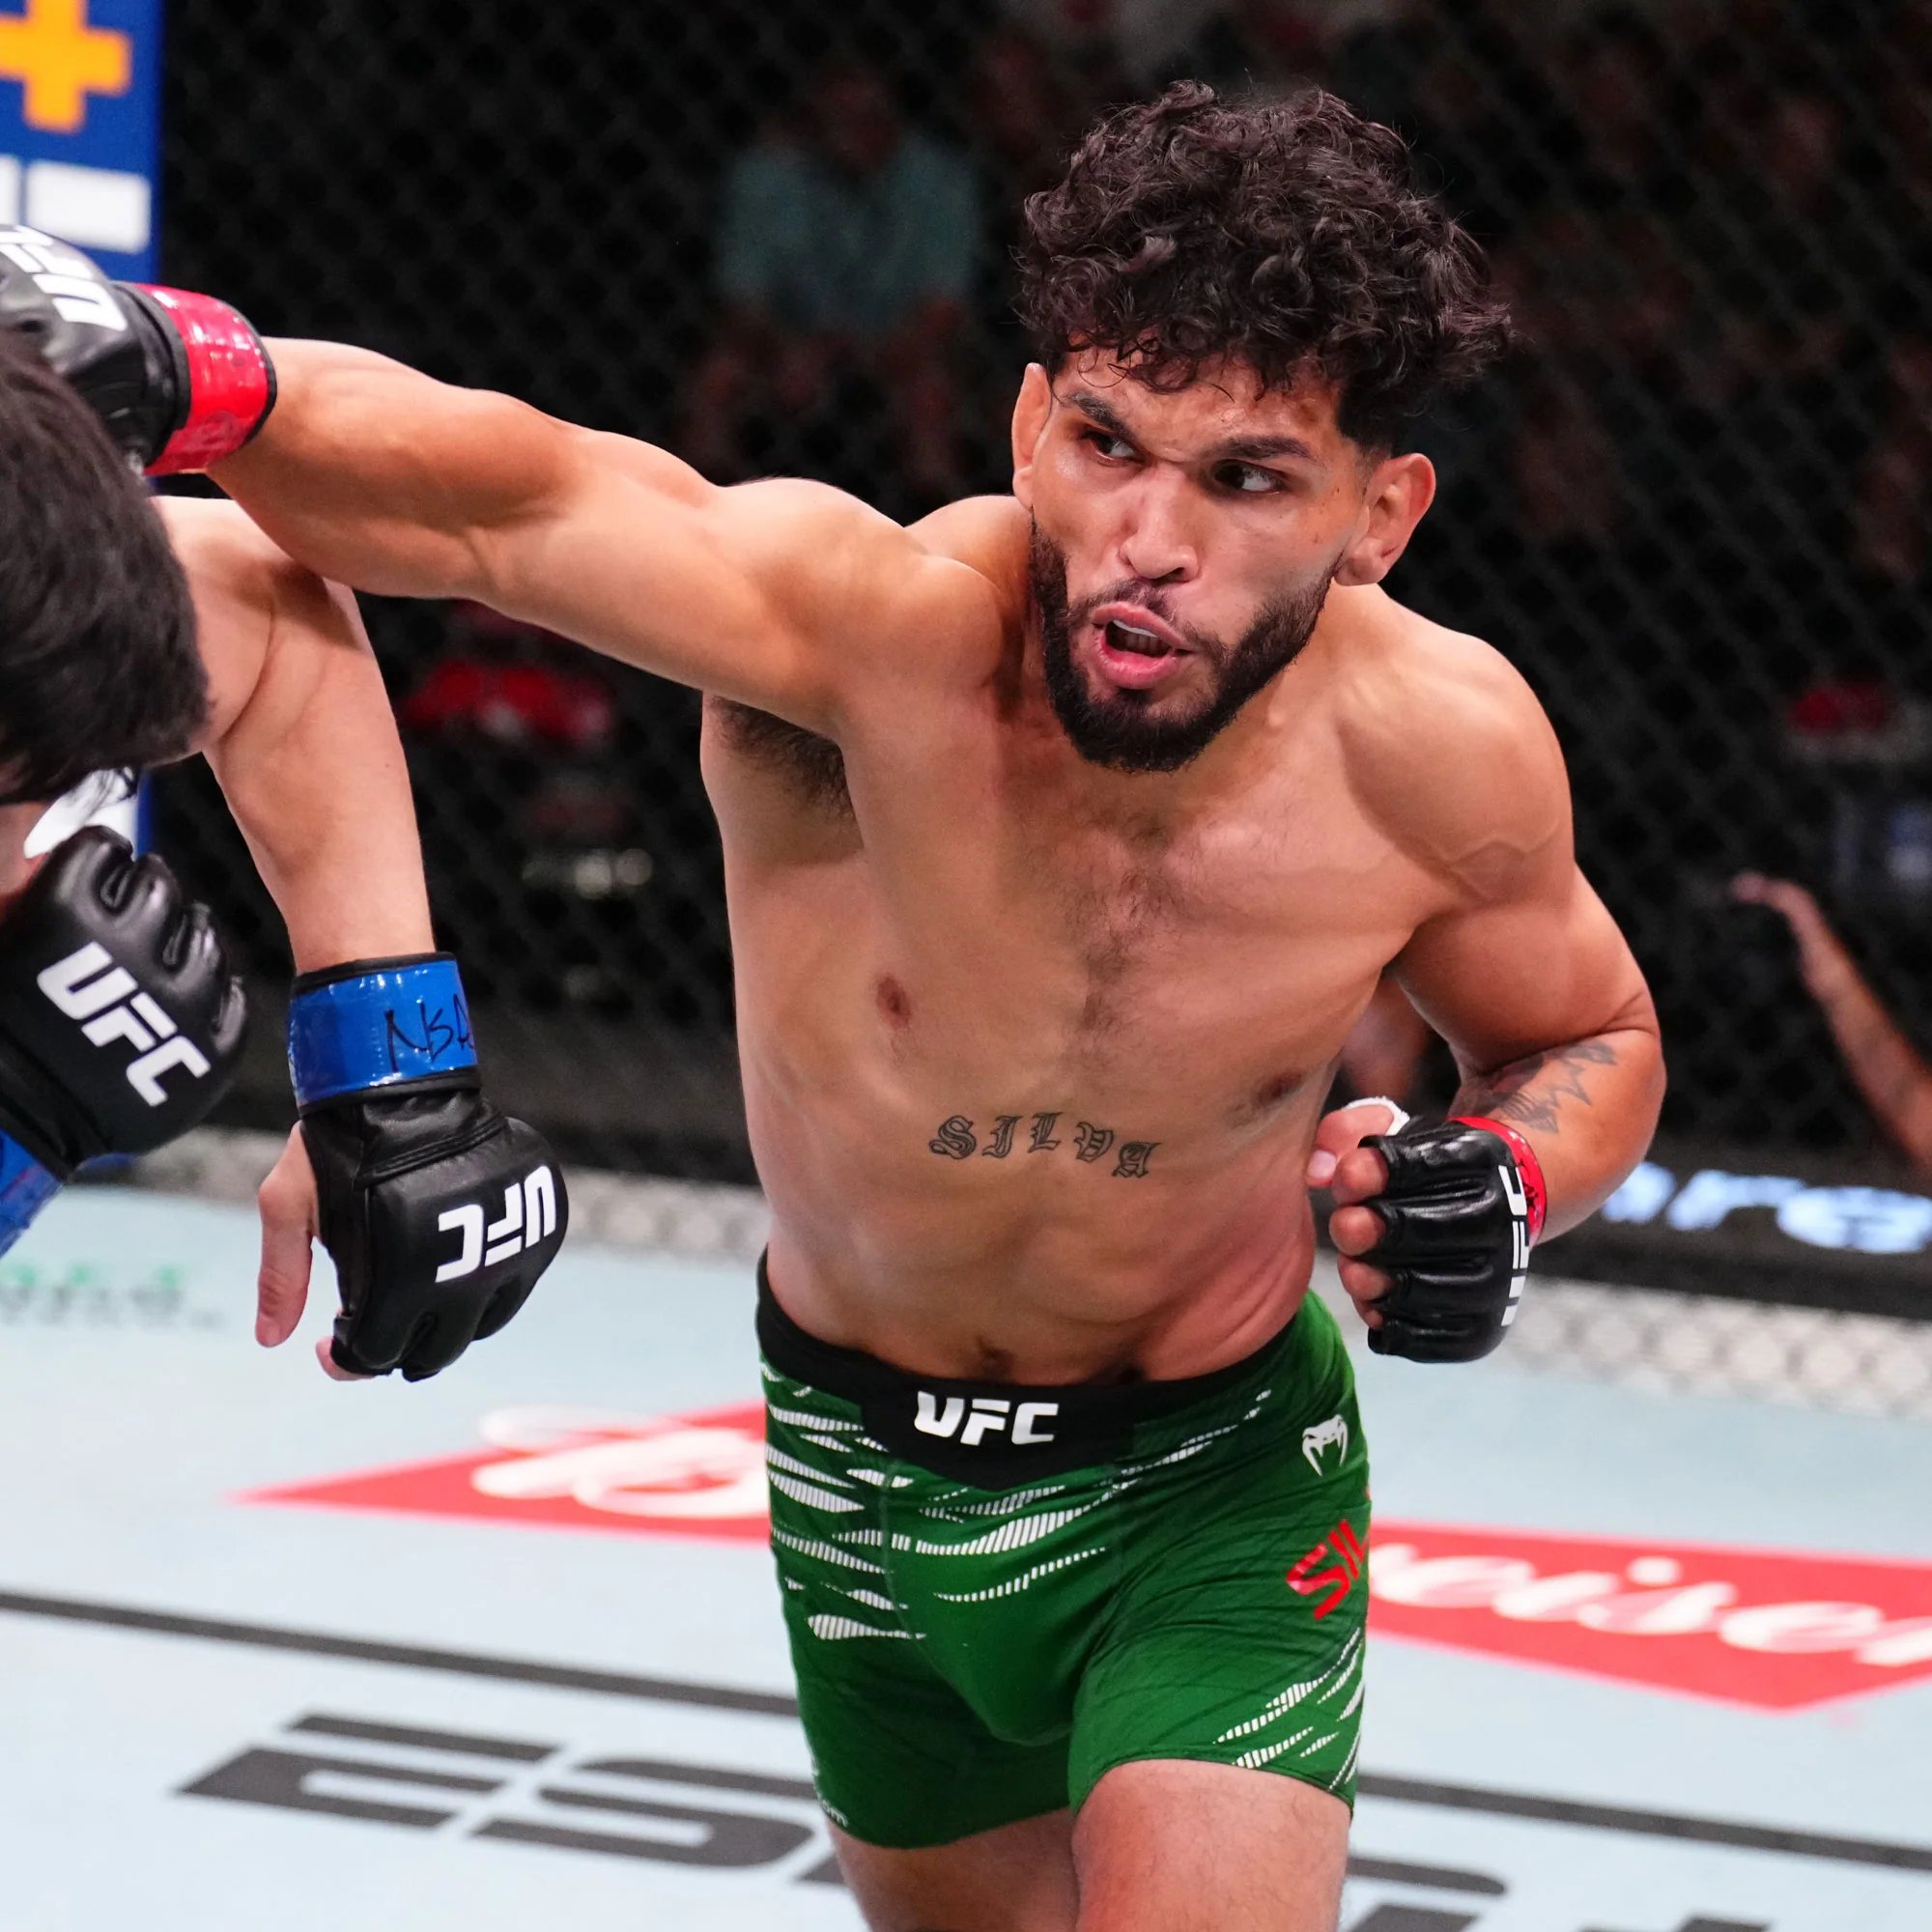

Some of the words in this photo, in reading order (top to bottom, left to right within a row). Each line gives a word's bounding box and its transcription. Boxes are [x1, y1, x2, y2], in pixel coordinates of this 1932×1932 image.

[37, 942, 211, 1107] UFC
[929, 1112, 1160, 1179] SILVA
[435, 1165, 557, 1283] UFC
[914, 1391, 1059, 1445] UFC
